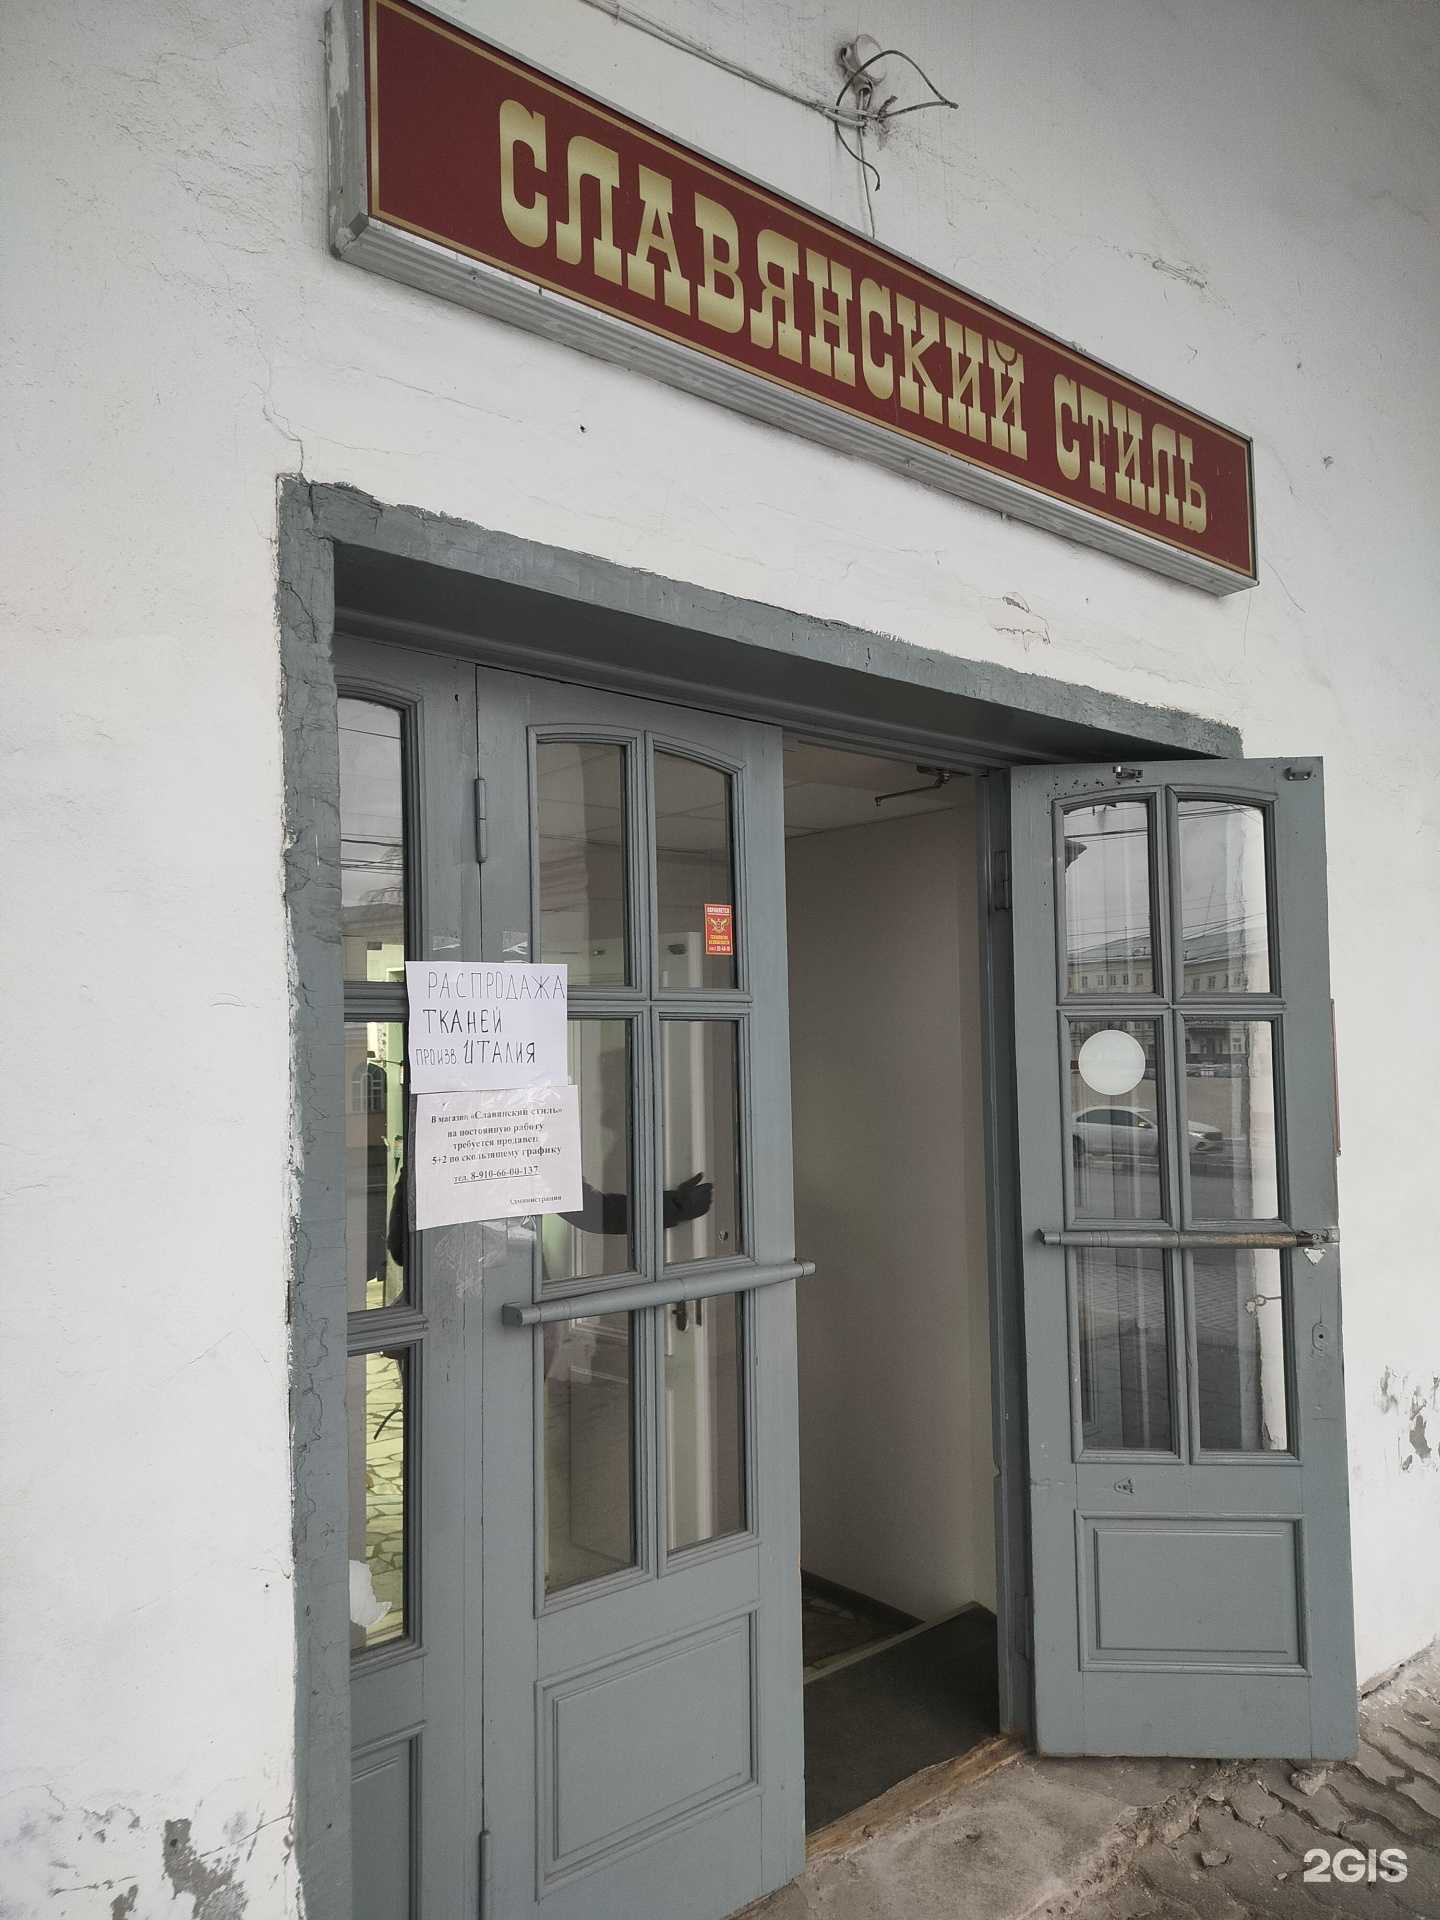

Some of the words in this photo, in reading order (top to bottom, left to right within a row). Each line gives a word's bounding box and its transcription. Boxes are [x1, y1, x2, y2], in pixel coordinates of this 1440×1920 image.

[498, 98, 1028, 462] СЛАВЯНСКИЙ
[1054, 373, 1207, 535] СТИЛЬ
[428, 971, 565, 1000] РАСПРОДАЖА
[422, 1006, 503, 1034] ТКАНЕЙ
[463, 1039, 536, 1065] ИТАЛИЯ
[431, 1115, 437, 1124] В
[438, 1114, 469, 1123] магазин
[447, 1129, 457, 1138] на
[459, 1125, 512, 1138] постоянную
[513, 1122, 544, 1134] работу
[431, 1155, 448, 1166] 5+2
[449, 1155, 460, 1164] по
[522, 1145, 562, 1159] графику
[453, 1138, 494, 1151] требуется
